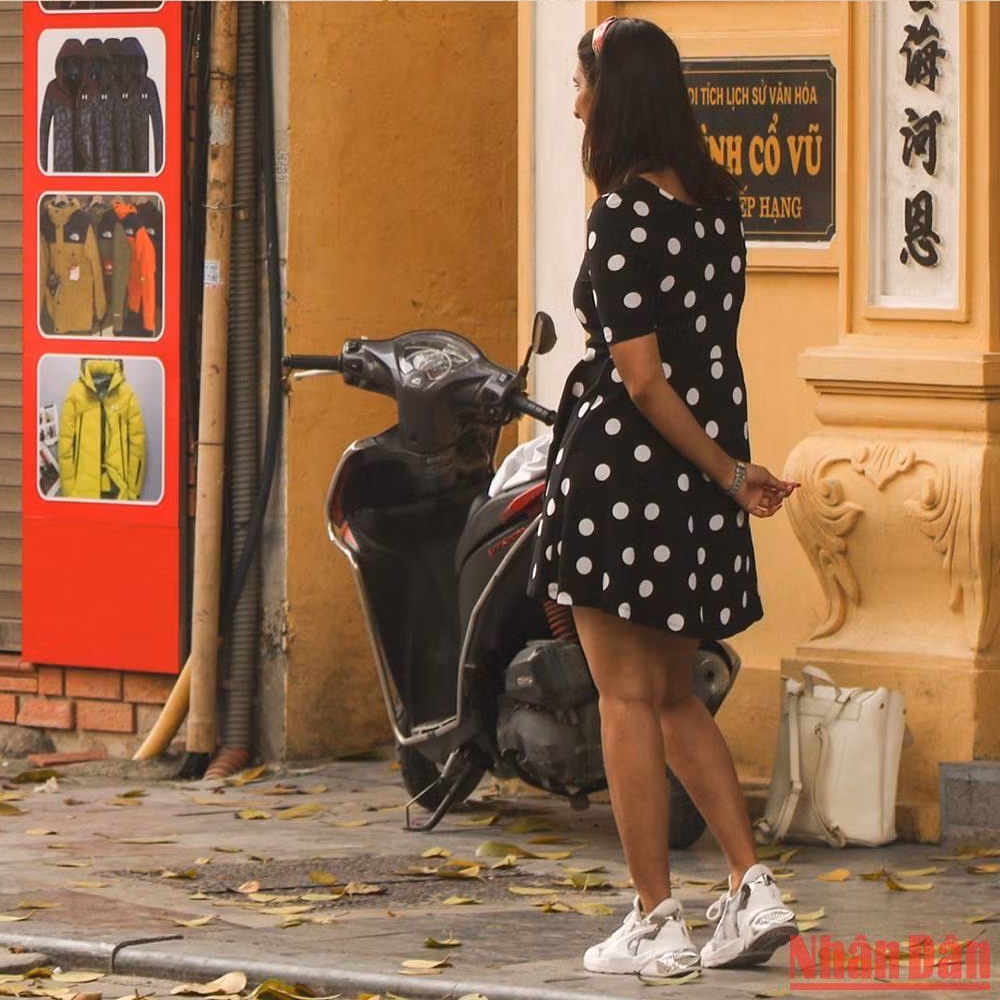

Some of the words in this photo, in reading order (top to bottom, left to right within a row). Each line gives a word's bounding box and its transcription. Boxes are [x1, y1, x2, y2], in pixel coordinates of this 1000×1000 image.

[700, 82, 724, 105] TÍCH
[726, 86, 750, 111] LỊCH
[752, 79, 768, 105] SỬ
[769, 81, 792, 105] VĂN
[794, 81, 818, 105] HÓA
[701, 123, 743, 176] NH
[748, 112, 781, 176] CỔ
[786, 123, 823, 176] VŨ
[759, 196, 802, 224] HẠNG
